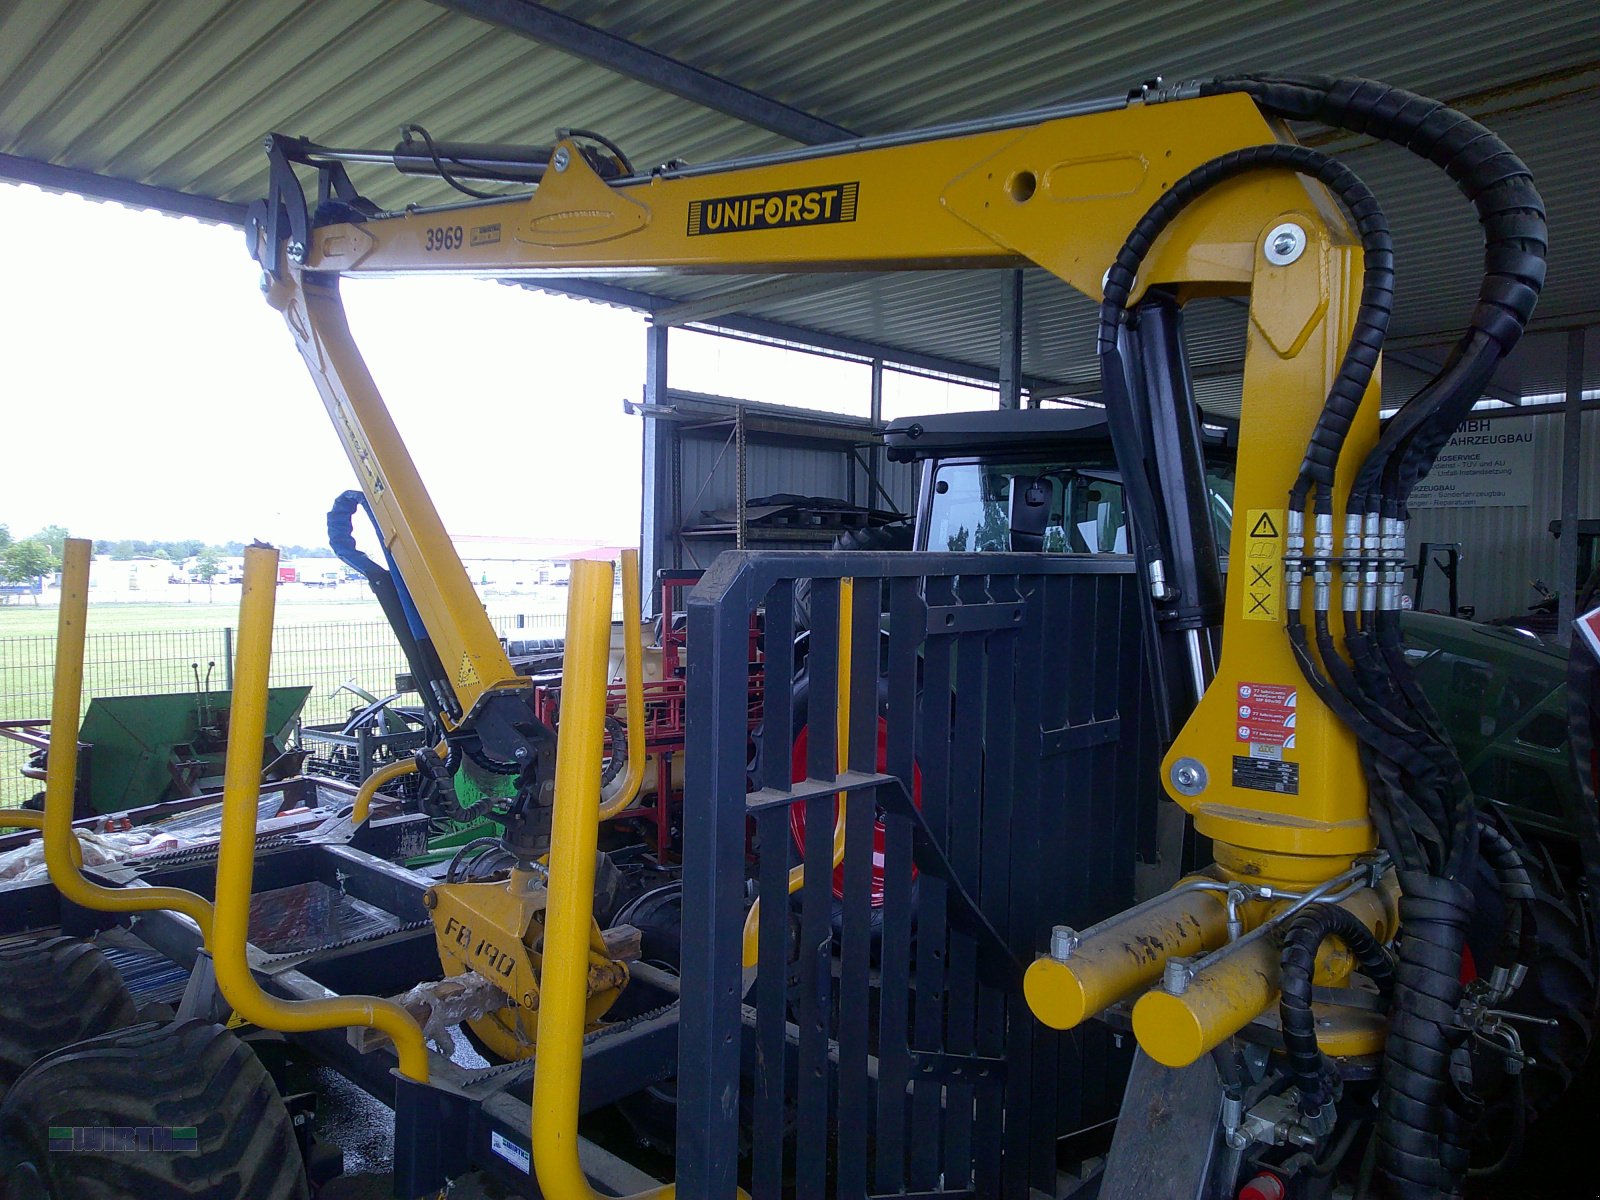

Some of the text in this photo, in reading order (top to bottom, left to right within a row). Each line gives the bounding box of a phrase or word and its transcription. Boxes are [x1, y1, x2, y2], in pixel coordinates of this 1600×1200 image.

[706, 190, 837, 230] UNIFORST
[425, 225, 463, 251] 3969
[475, 939, 516, 978] 190
